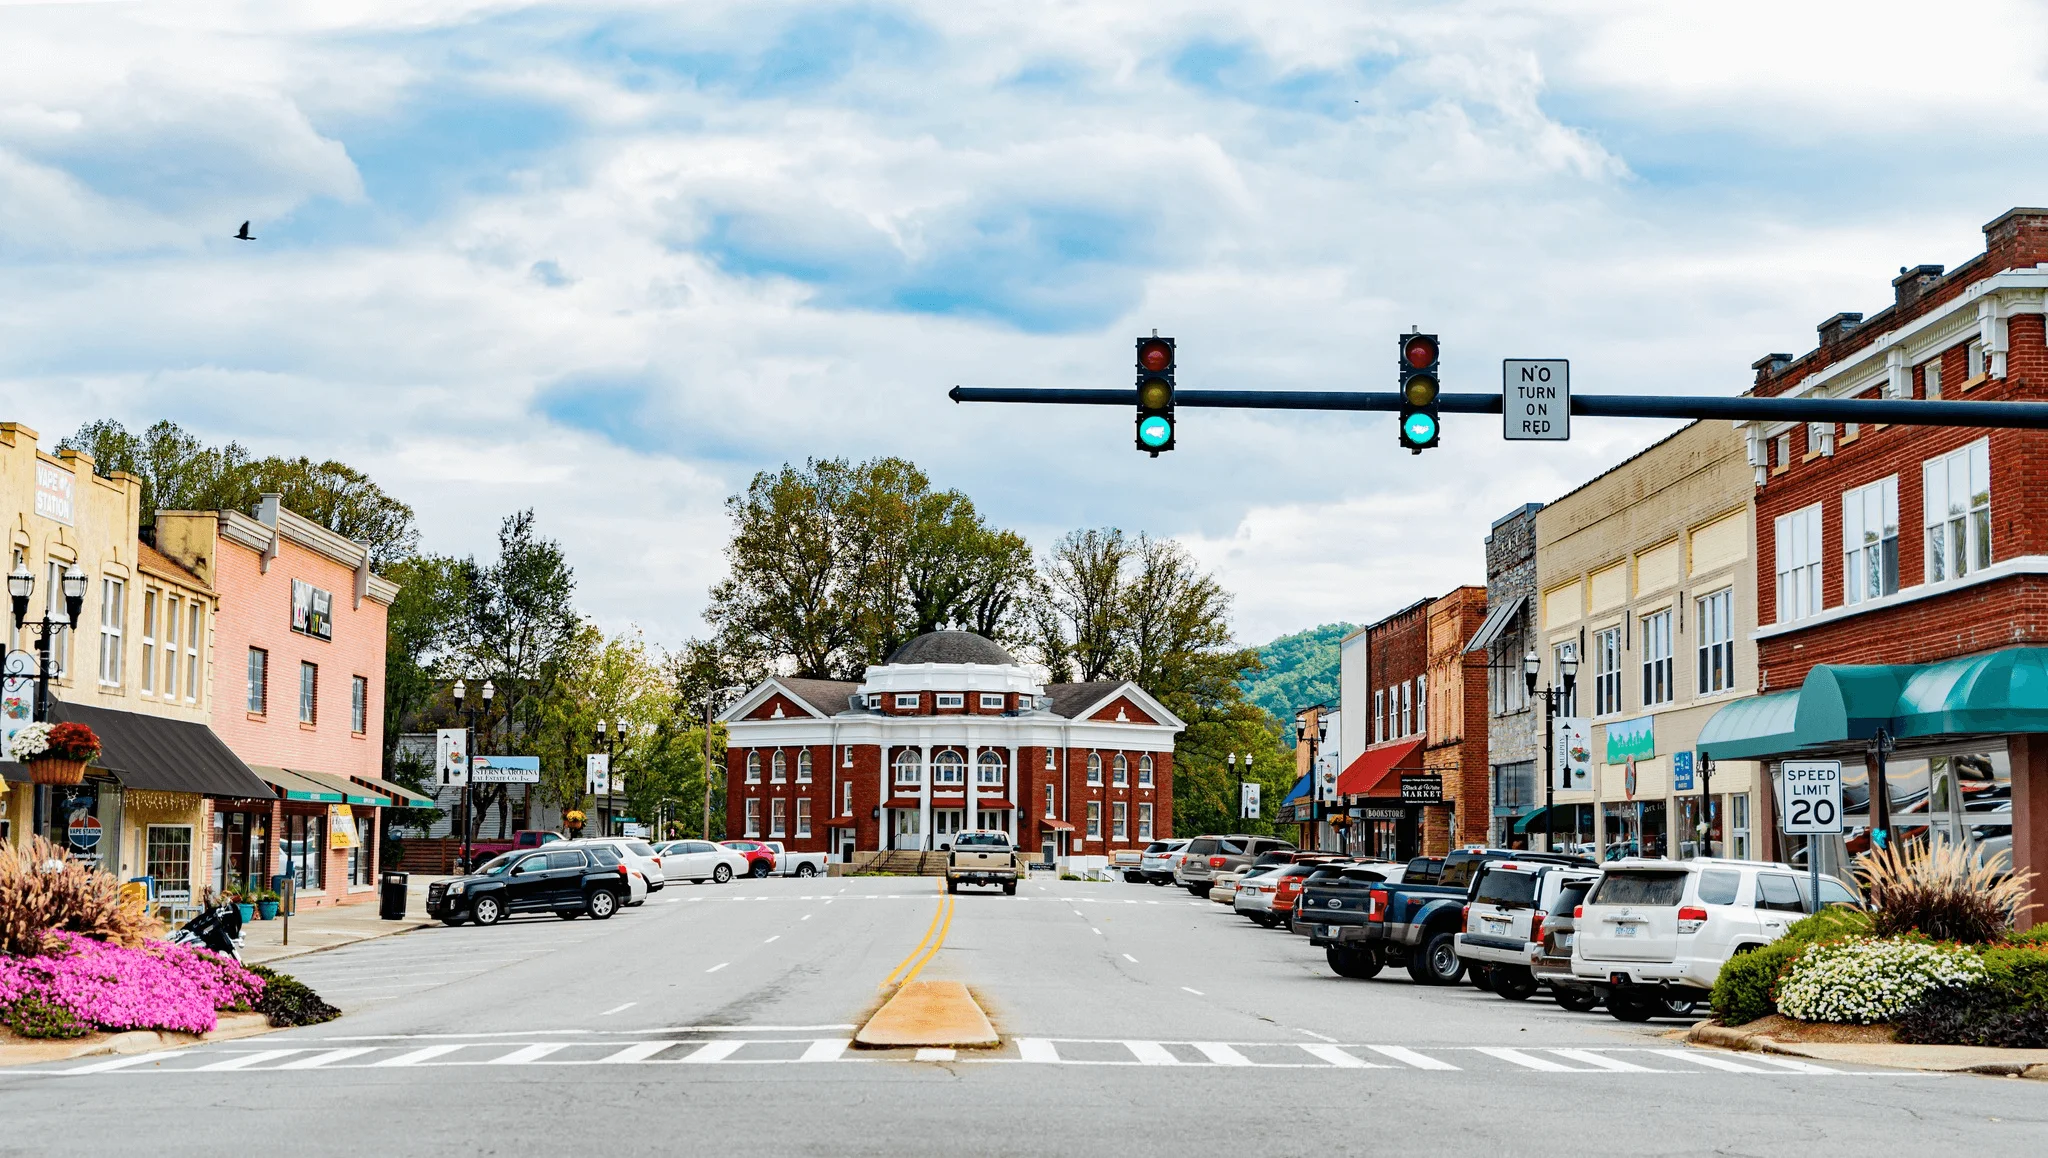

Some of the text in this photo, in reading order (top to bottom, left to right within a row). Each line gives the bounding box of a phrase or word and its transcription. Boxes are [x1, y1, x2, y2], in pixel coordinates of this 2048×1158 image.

[1522, 367, 1551, 382] NO
[1518, 387, 1555, 399] TURN
[1526, 403, 1547, 416] ON
[1522, 420, 1551, 433] RED
[38, 466, 58, 491] VAPE
[37, 491, 68, 518] STATION
[500, 767, 538, 775] CAROLINA
[1788, 770, 1836, 781] SPEED
[1793, 785, 1831, 795] LIMIT
[1368, 809, 1404, 818] BOOKSTORE
[1791, 799, 1835, 825] 20
